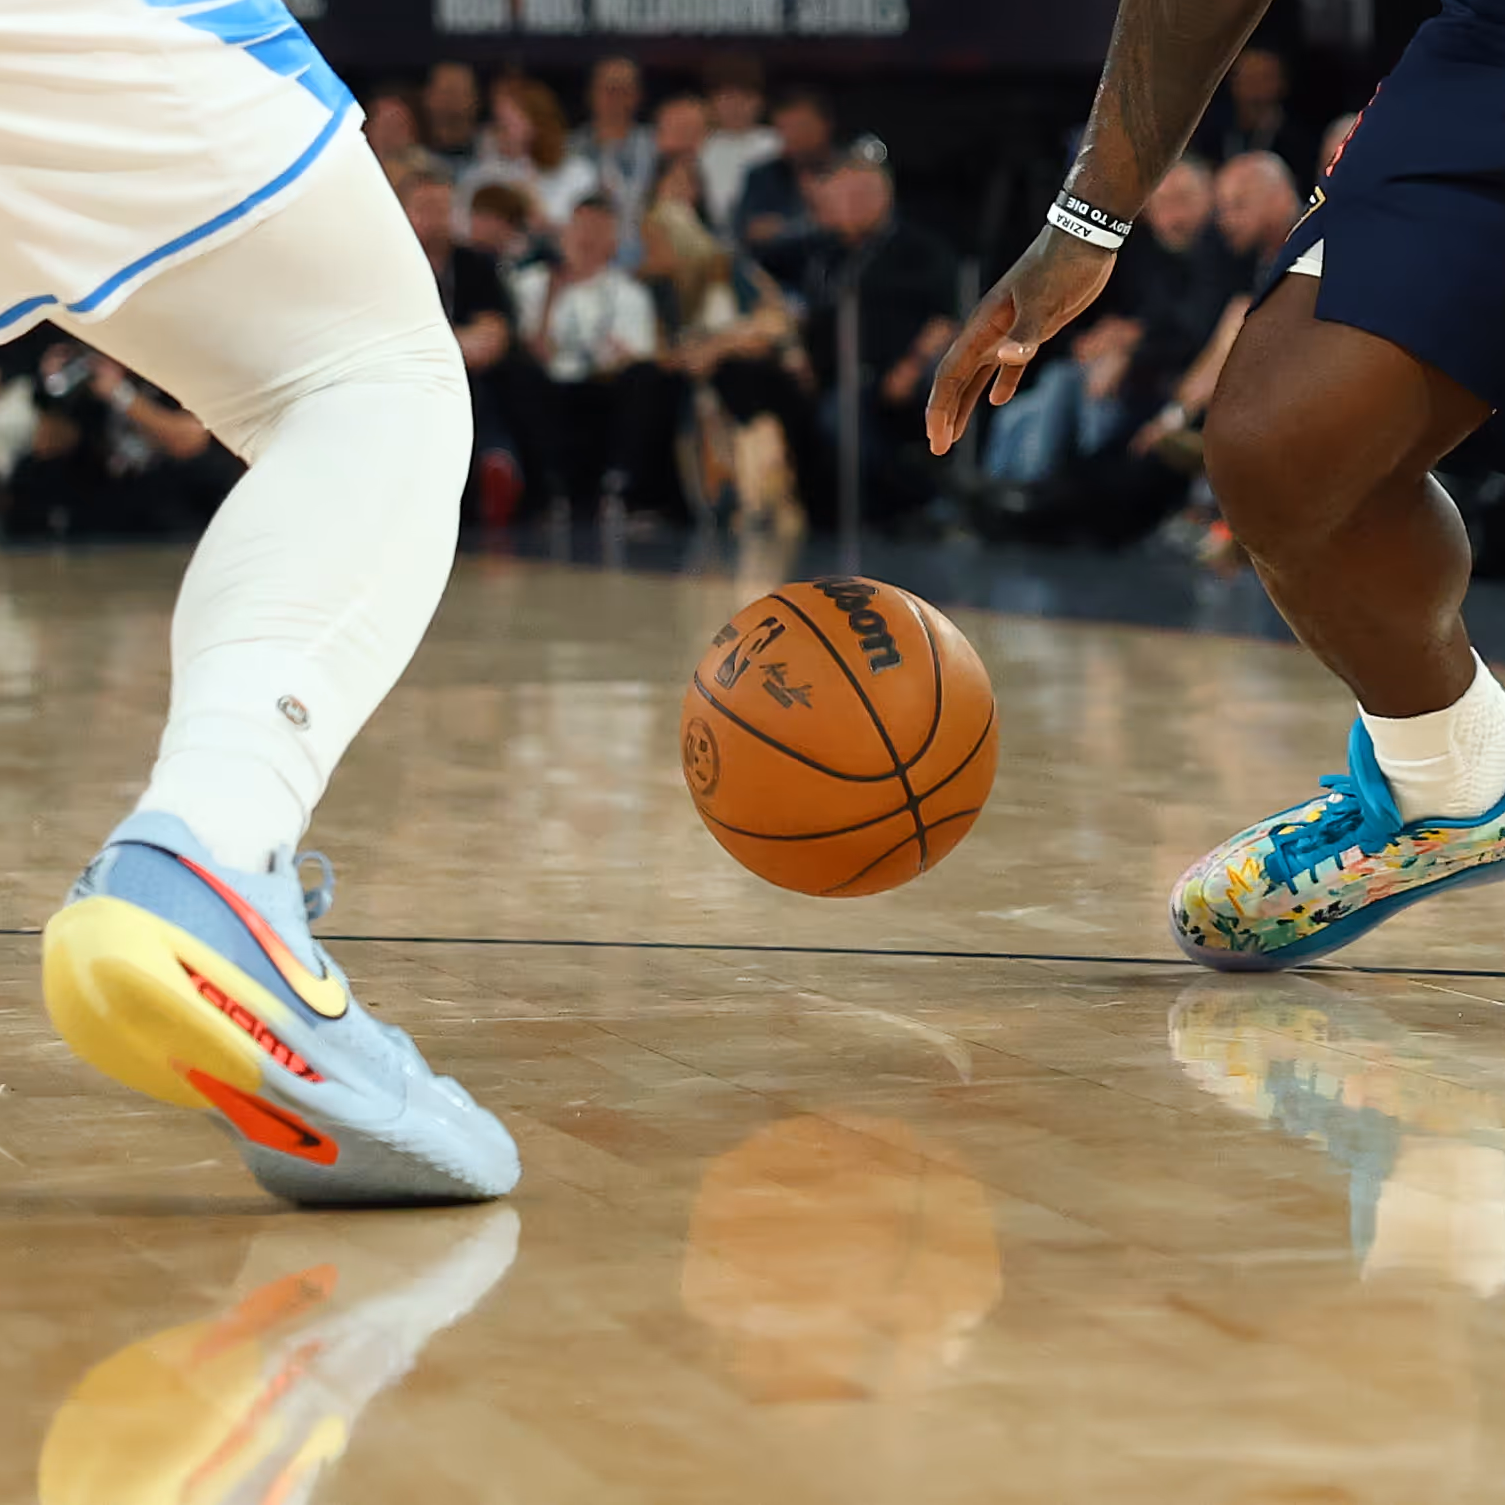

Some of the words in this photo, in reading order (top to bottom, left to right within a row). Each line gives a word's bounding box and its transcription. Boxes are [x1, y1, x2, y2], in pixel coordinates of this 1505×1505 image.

[1065, 196, 1090, 215] DIE
[1056, 212, 1093, 238] AZIRA
[1090, 209, 1109, 225] TO
